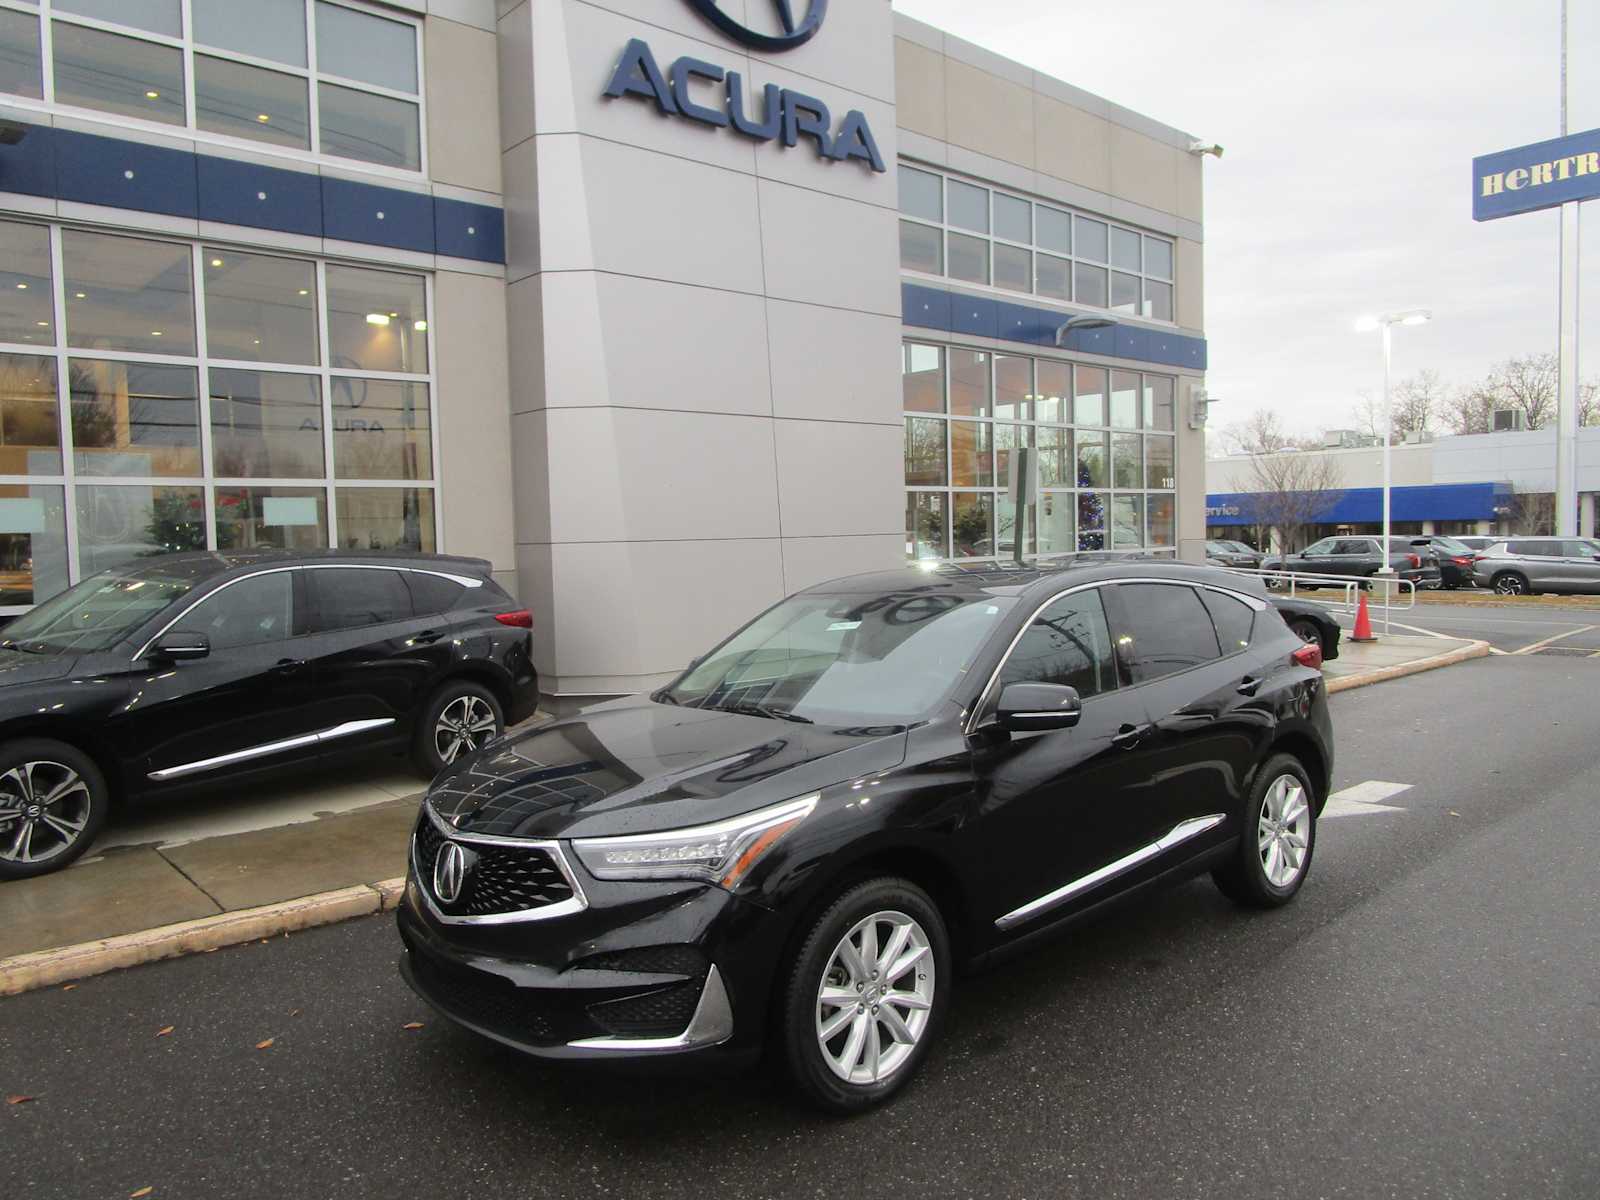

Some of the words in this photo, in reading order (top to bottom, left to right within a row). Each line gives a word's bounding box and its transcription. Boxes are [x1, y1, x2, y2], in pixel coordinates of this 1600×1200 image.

[601, 38, 886, 173] ACURA
[299, 417, 384, 432] AURA
[1161, 477, 1174, 489] 118
